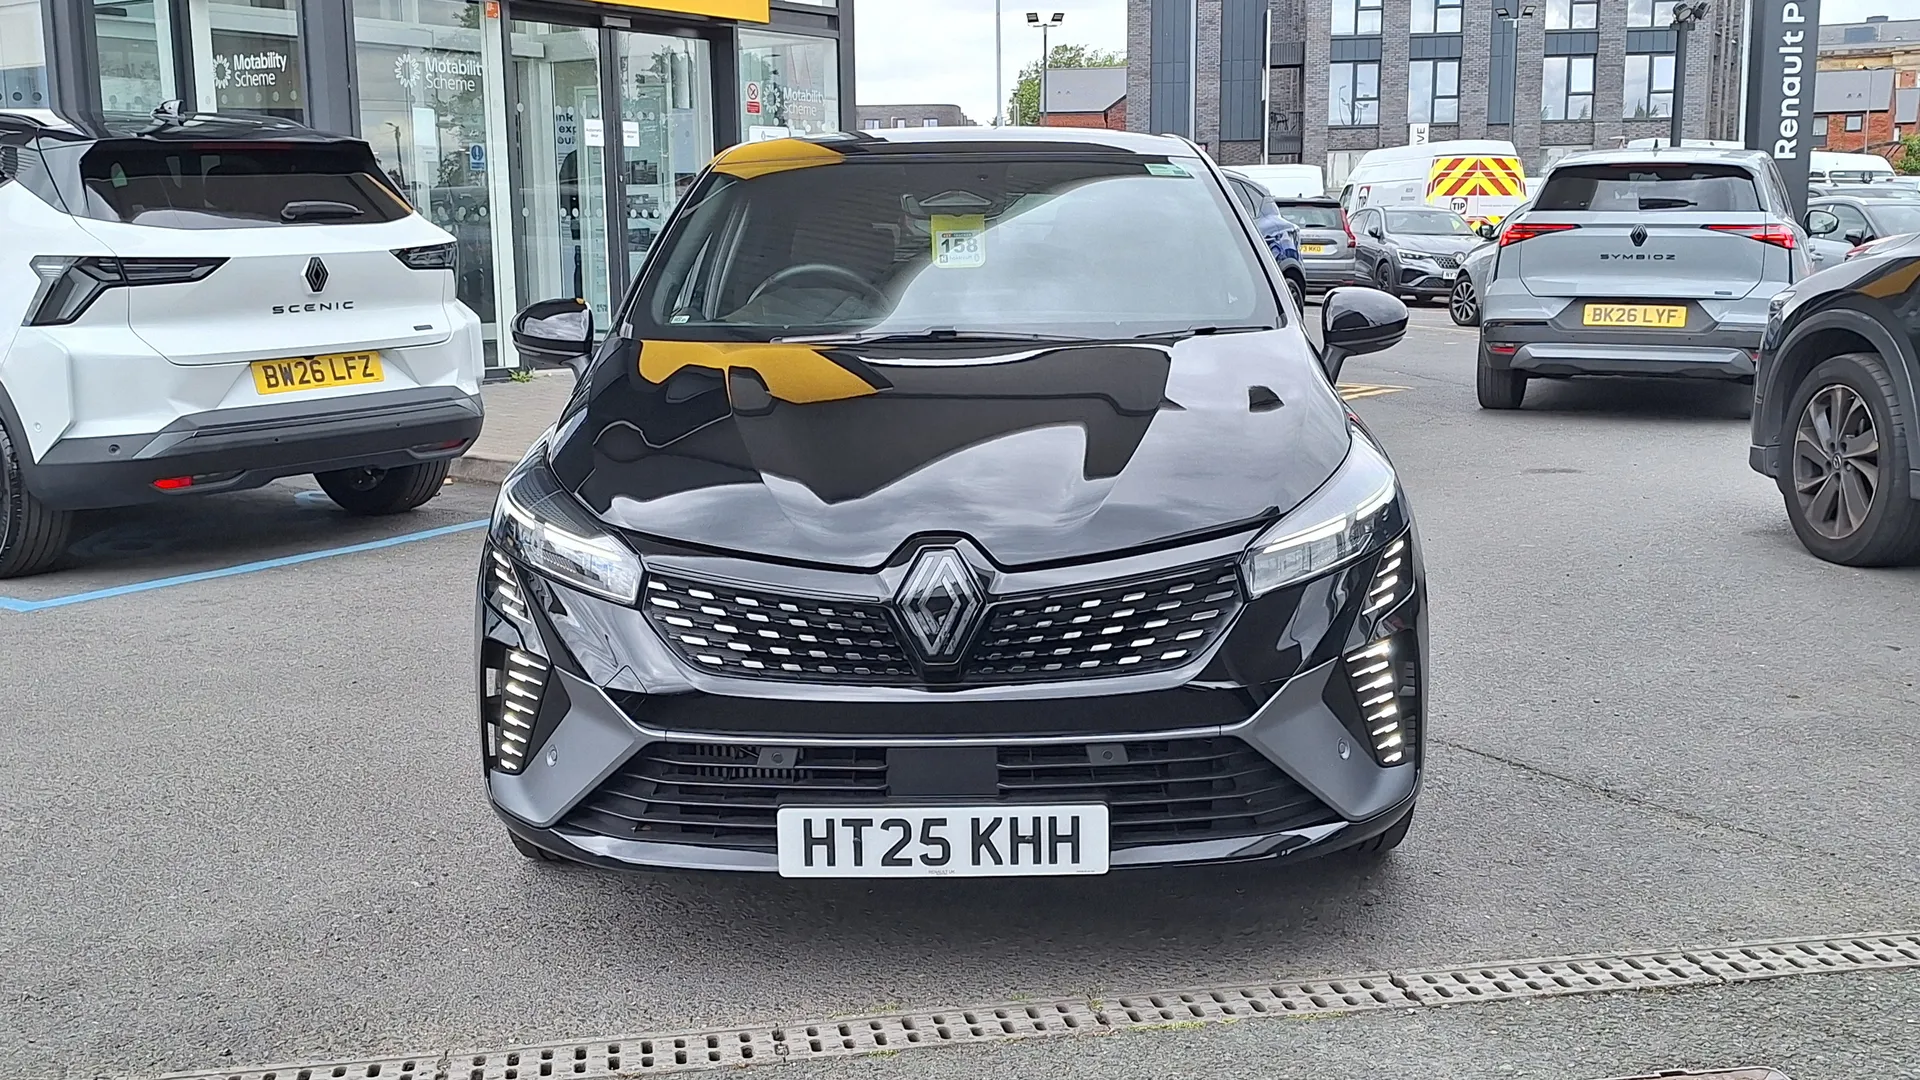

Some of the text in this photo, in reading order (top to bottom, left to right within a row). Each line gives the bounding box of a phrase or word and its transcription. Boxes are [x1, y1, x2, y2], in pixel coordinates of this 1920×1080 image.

[233, 51, 287, 72] Motability
[424, 57, 484, 77] Motabilit
[235, 71, 276, 87] Scheme
[425, 73, 476, 92] Scheme
[1774, 2, 1805, 159] Renault P
[783, 101, 817, 117] Scheme
[1452, 202, 1465, 210] TIP
[941, 238, 978, 253] 158
[272, 301, 354, 314] SCENIC
[1592, 307, 1678, 324] BK26 LYF
[262, 355, 374, 389] BW26 LFZ
[803, 815, 1080, 867] HT25 KHH
